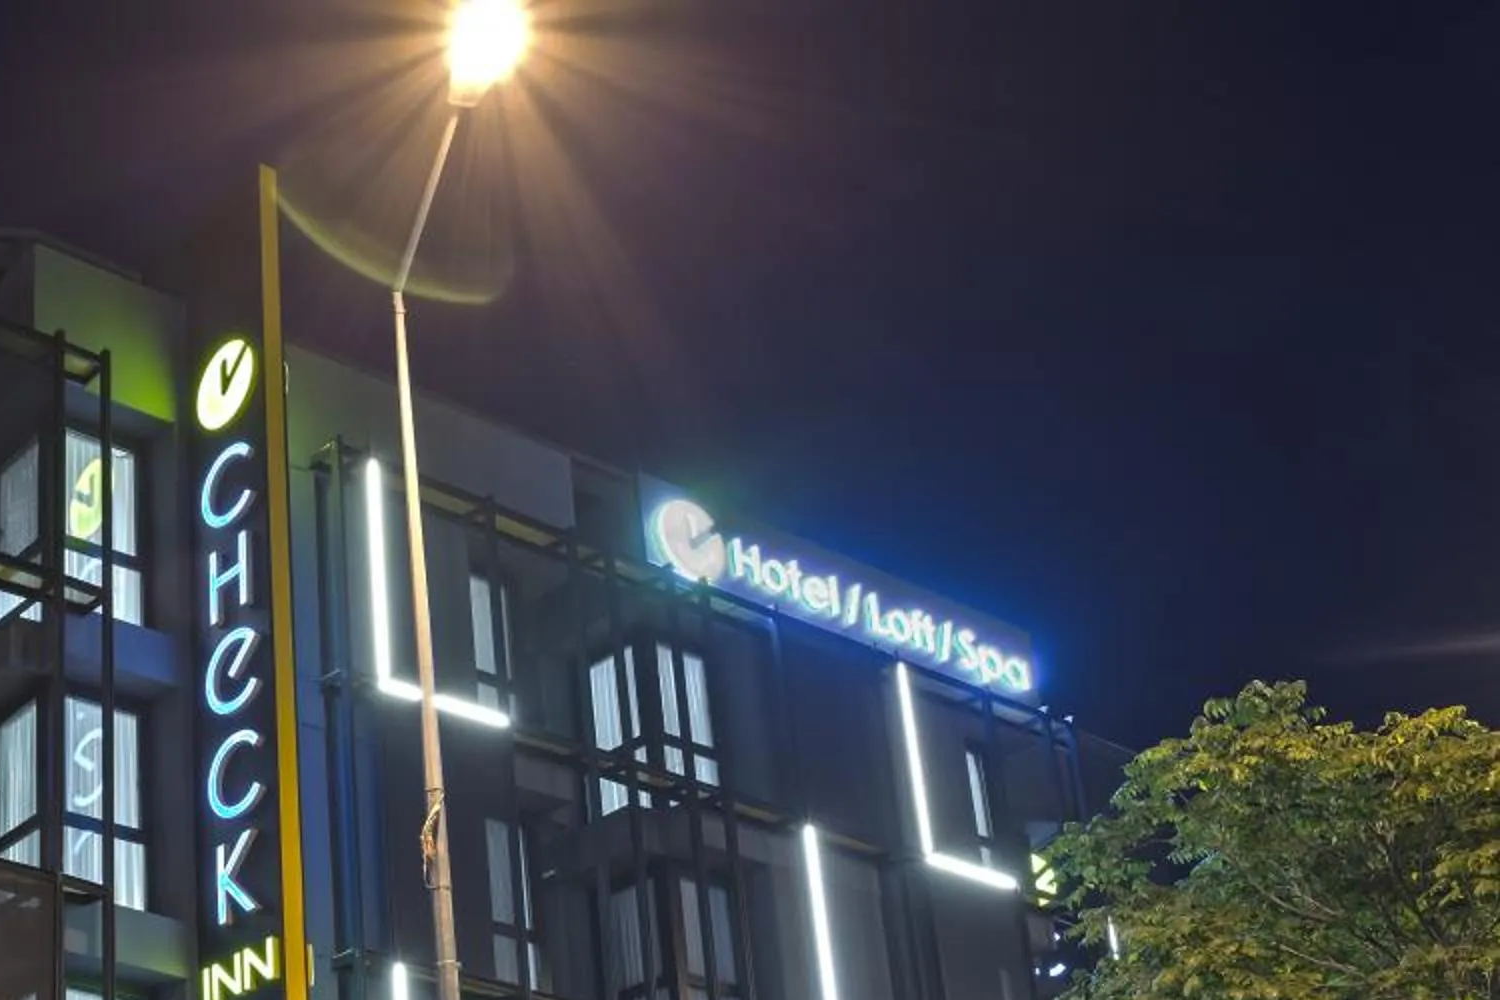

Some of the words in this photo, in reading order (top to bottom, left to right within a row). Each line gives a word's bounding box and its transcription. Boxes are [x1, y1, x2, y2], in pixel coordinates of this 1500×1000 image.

[726, 536, 842, 618] Hotel
[864, 591, 935, 653] Loft
[953, 628, 1032, 693] Spa
